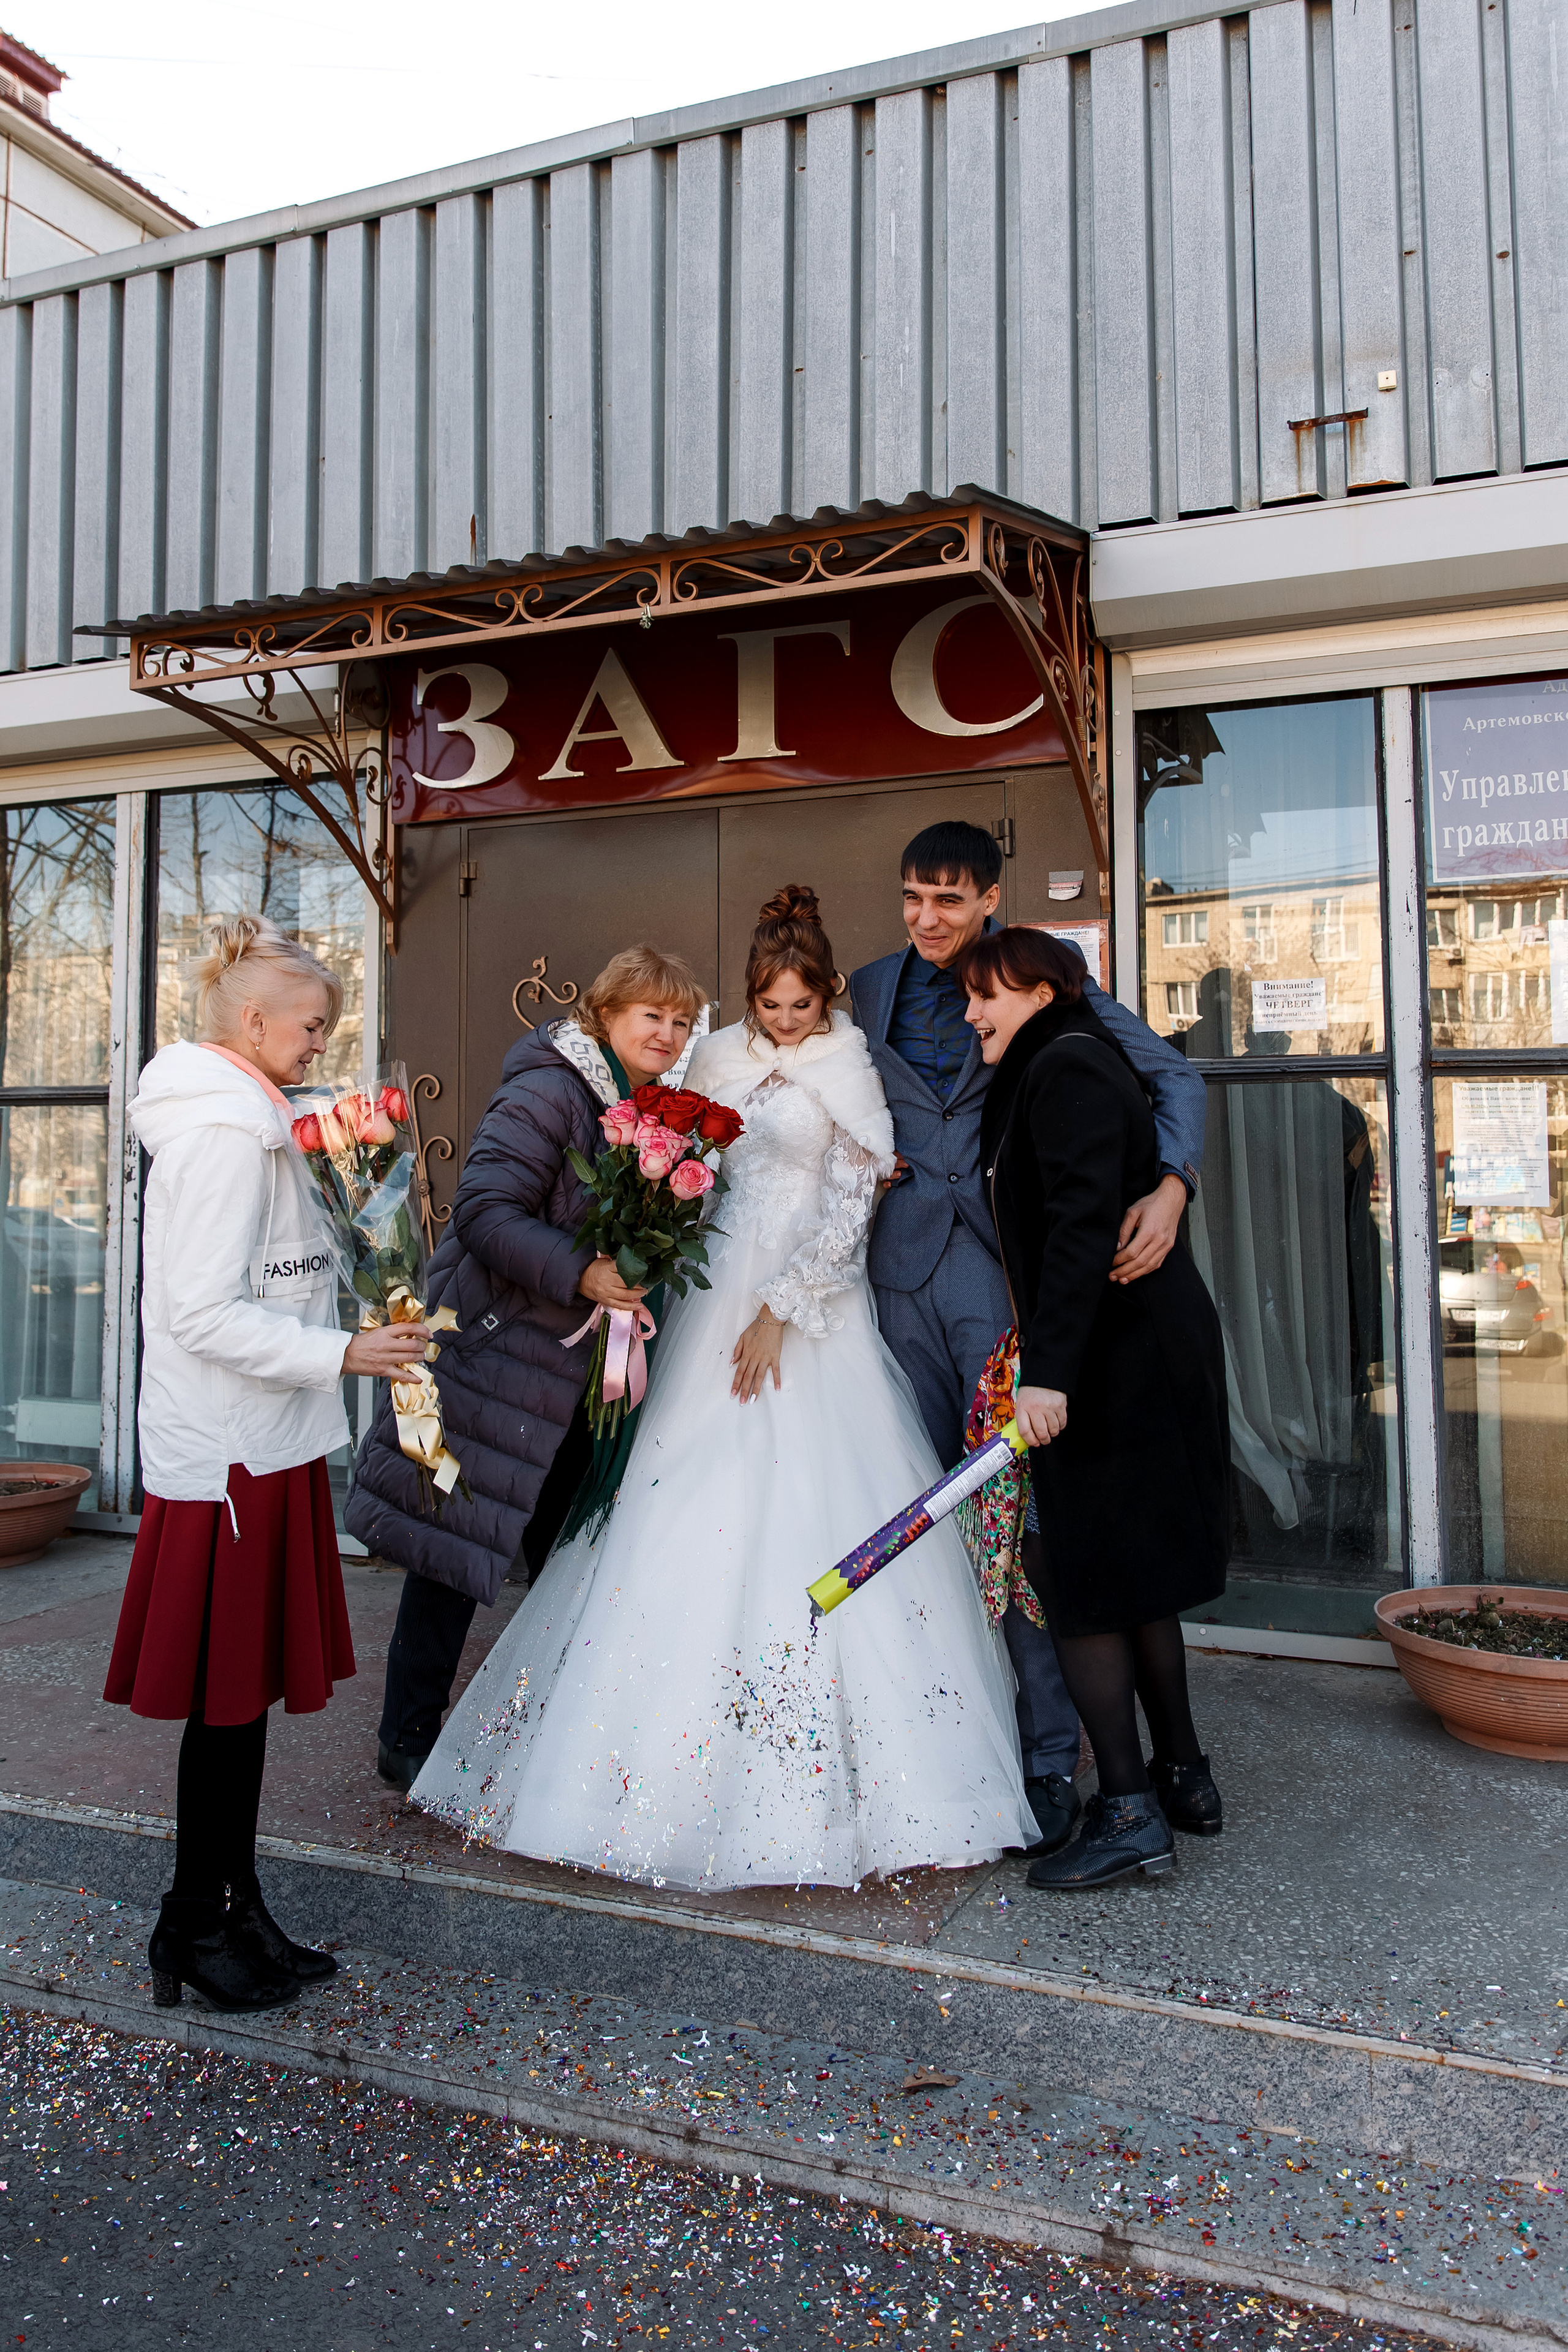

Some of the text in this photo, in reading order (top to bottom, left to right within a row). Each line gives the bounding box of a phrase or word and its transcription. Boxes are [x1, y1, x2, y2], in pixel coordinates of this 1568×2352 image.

[412, 594, 1043, 790] ЗАГС
[1463, 710, 1568, 733] Артемовск
[1443, 818, 1568, 857] граждан
[1264, 981, 1314, 990] Внимание!
[1265, 999, 1314, 1009] ЧЕТВЕРГ
[264, 1253, 329, 1280] FASHION
